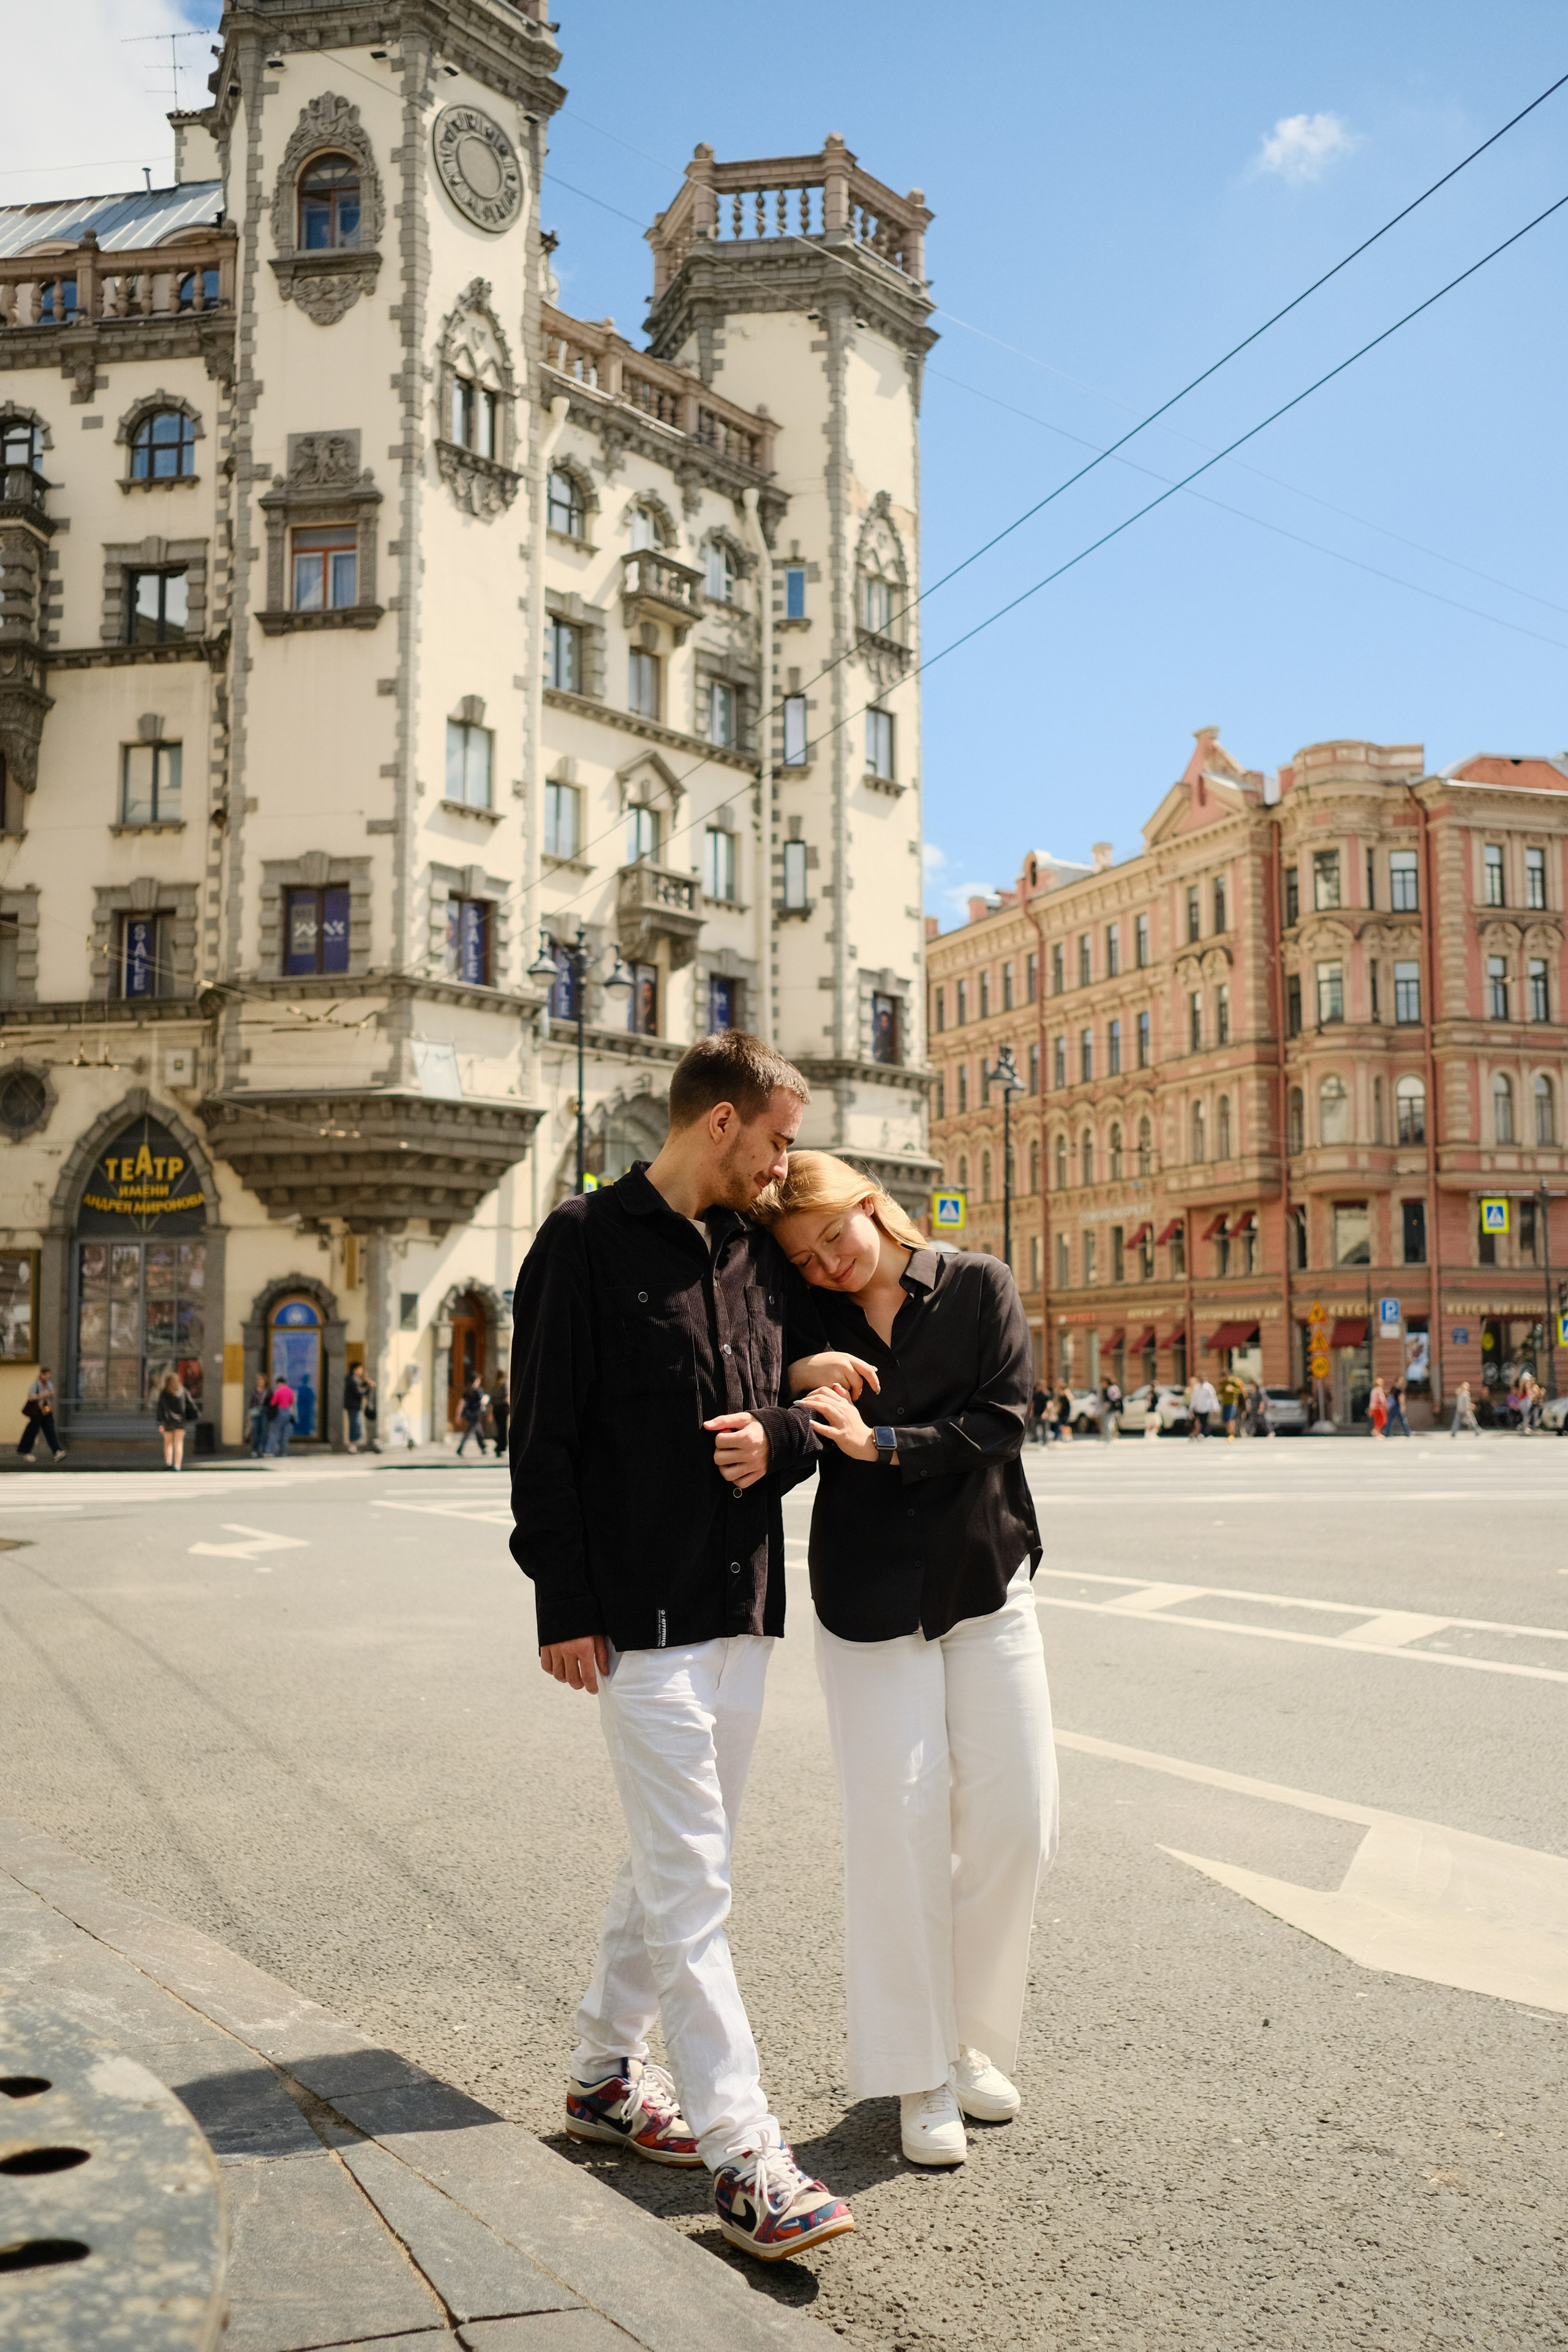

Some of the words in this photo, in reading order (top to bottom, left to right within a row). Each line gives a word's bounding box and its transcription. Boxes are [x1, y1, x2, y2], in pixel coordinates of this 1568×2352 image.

[134, 923, 146, 990] SALE
[467, 910, 479, 979] SALE
[105, 1144, 184, 1182] ТЕАТР
[83, 1194, 133, 1214] АНДРЕЯ
[134, 1191, 205, 1214] МИРОНОВА
[119, 1184, 170, 1198] ИМЕНИ
